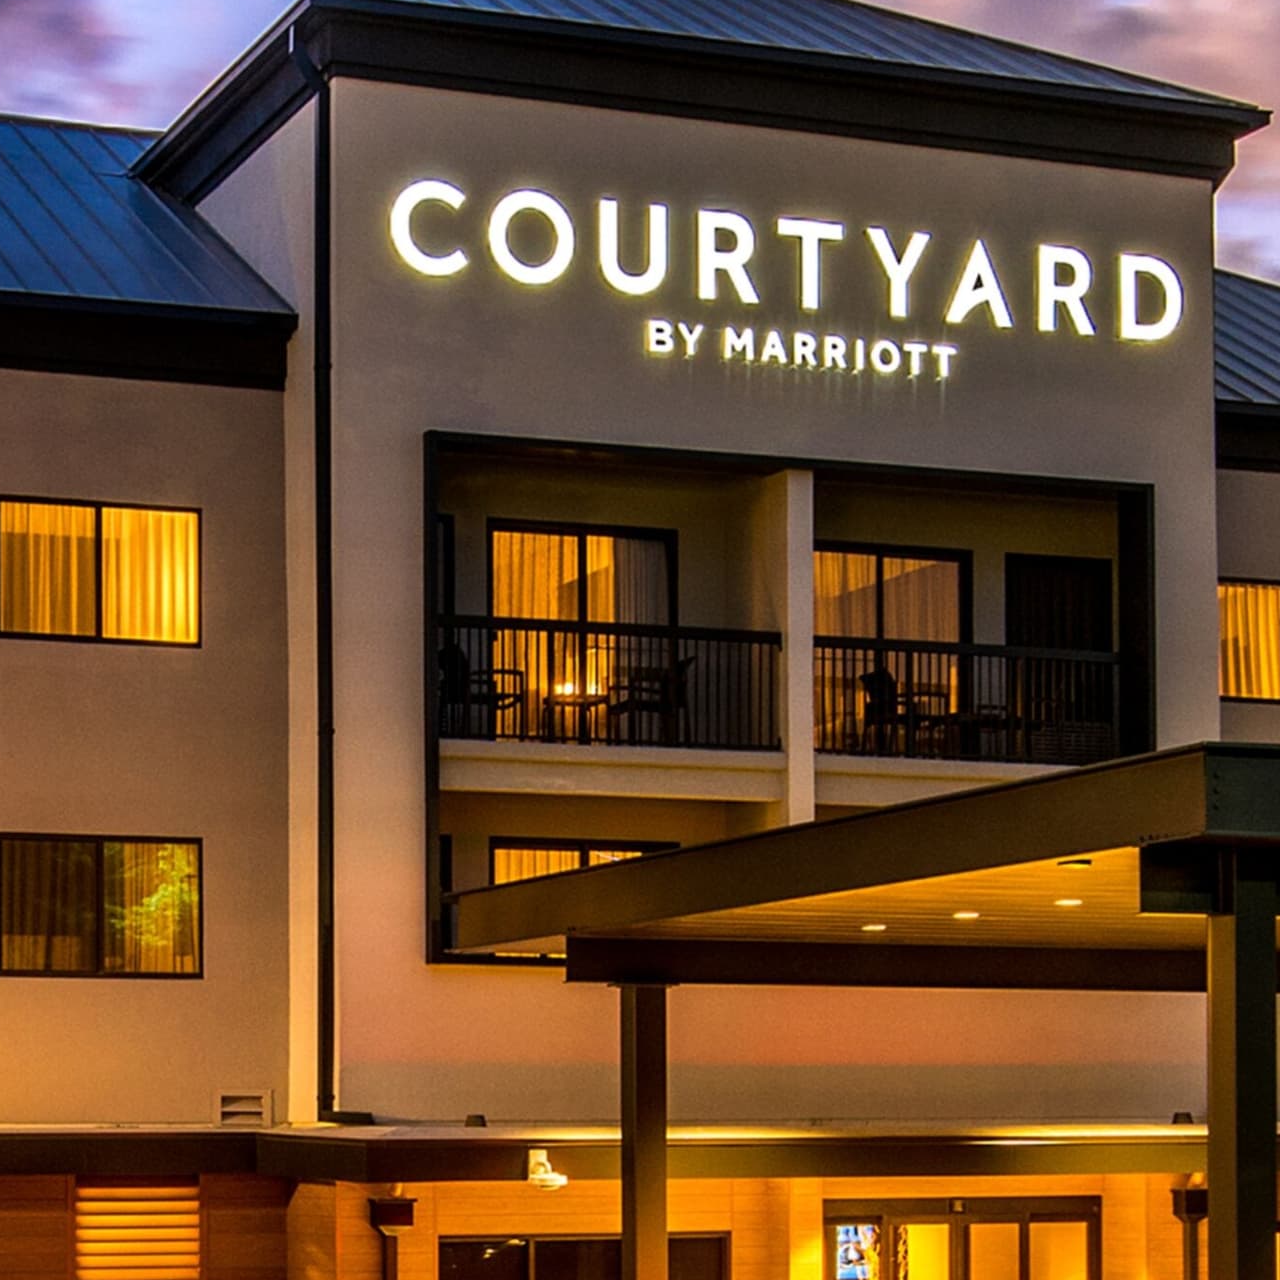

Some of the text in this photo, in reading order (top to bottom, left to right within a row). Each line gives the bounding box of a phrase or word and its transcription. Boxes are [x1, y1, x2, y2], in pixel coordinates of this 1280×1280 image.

[389, 179, 1183, 341] COURTYARD
[647, 319, 959, 379] BY MARRIOTT
